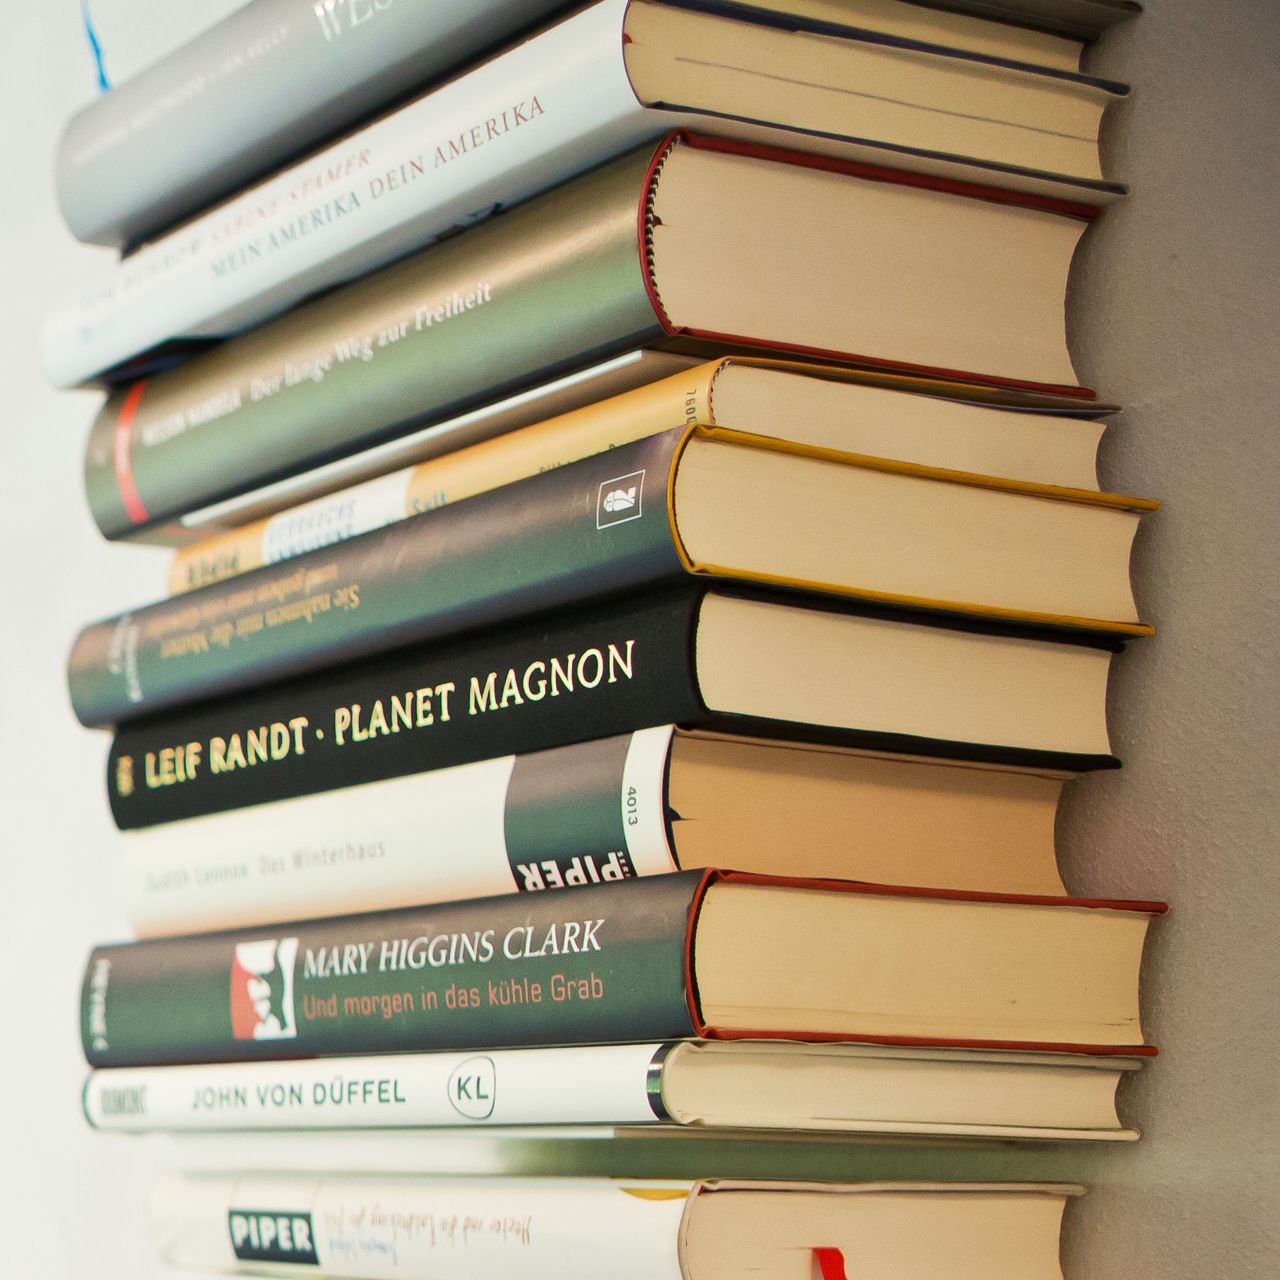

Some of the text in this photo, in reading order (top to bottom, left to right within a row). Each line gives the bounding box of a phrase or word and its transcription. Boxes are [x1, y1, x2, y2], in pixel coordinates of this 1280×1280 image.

[267, 191, 361, 249] AMERIKA
[369, 157, 425, 200] DEIN
[433, 95, 545, 169] AMERIKA
[335, 338, 373, 362] Weg
[378, 323, 407, 346] zur
[415, 282, 491, 331] Freiheit
[146, 742, 201, 788] LEIF
[210, 717, 308, 774] RANDT
[335, 682, 455, 745] PLANET
[469, 640, 635, 715] MAGNON
[626, 786, 638, 826] 4013
[259, 851, 286, 875] Das
[292, 840, 386, 872] Winterhaus
[517, 852, 624, 892] PIPER
[304, 919, 605, 979] MARY HIGGINS CLARK
[304, 971, 604, 1021] Und morgen in das kühle Grab
[192, 1074, 407, 1112] JOHN VON DÜFFEL
[457, 1075, 490, 1101] KL
[230, 1214, 314, 1251] PIPER
